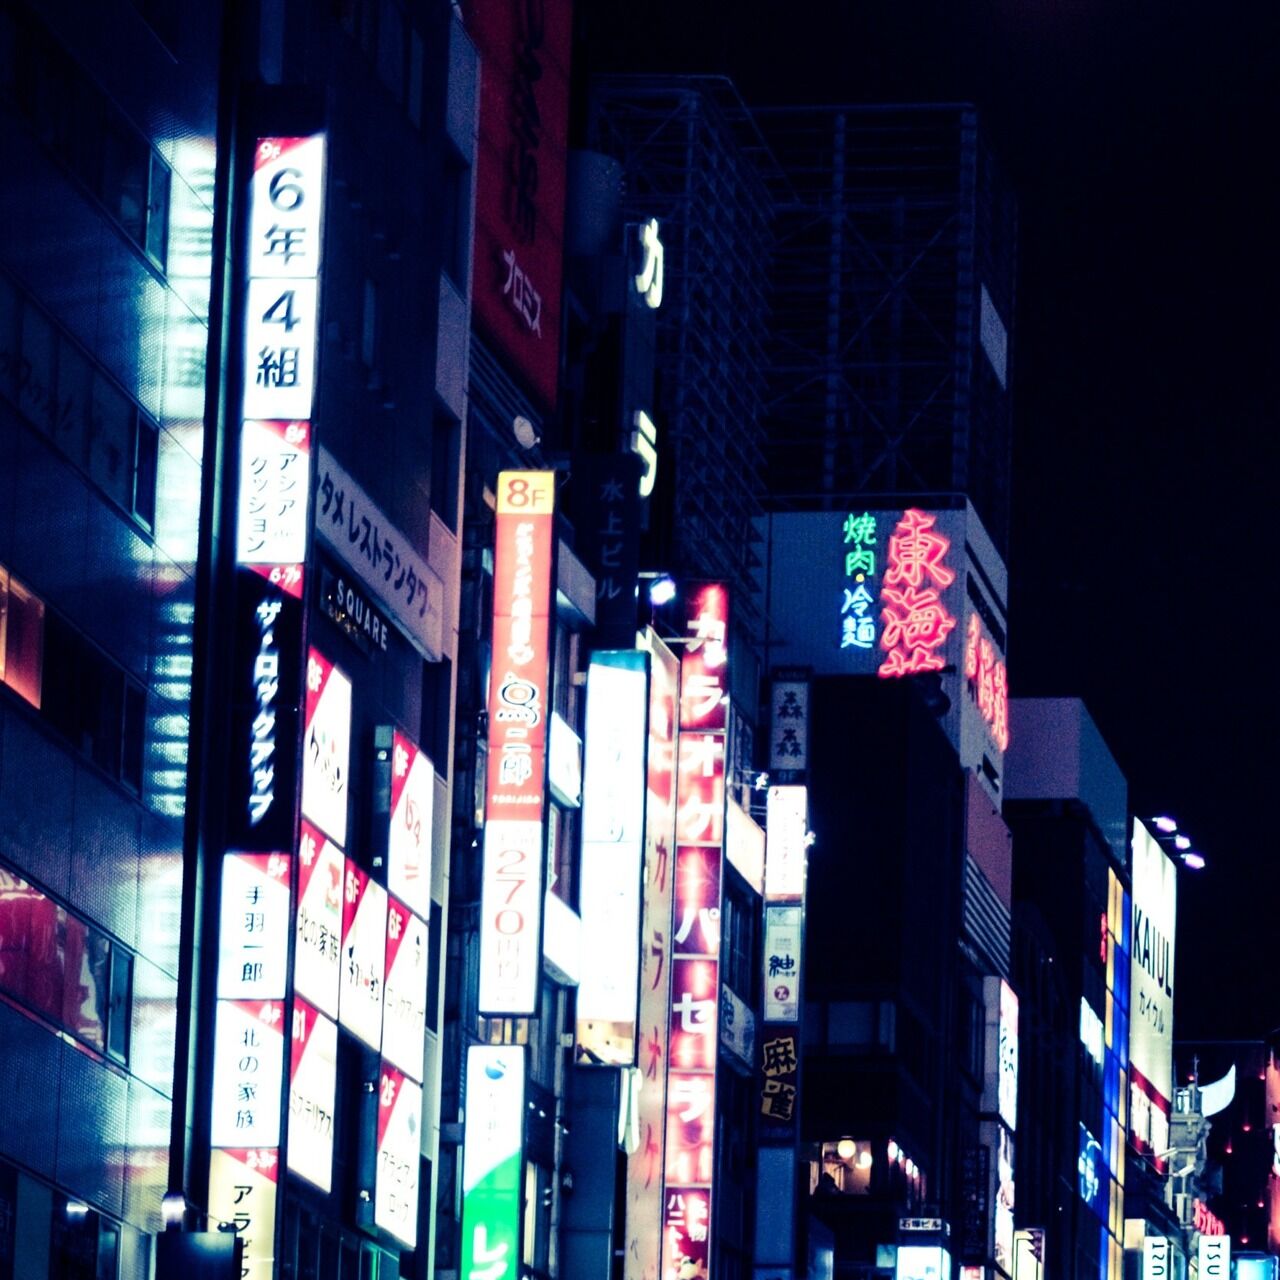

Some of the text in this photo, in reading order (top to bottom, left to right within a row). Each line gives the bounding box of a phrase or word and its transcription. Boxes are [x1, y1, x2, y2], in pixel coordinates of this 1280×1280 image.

[256, 168, 307, 390] 6年4組
[247, 457, 268, 553] クッション
[507, 478, 546, 508] 8F
[598, 478, 625, 600] 水上ビル
[317, 470, 433, 618] タメレストランタワー
[840, 511, 877, 650] 焼肉・冷麺
[336, 579, 389, 651] SQUARE
[240, 884, 265, 984] 手羽一郎
[1132, 902, 1173, 999] KAIUL
[235, 1027, 261, 1129] 北の家族
[761, 1037, 797, 1121] 麻雀
